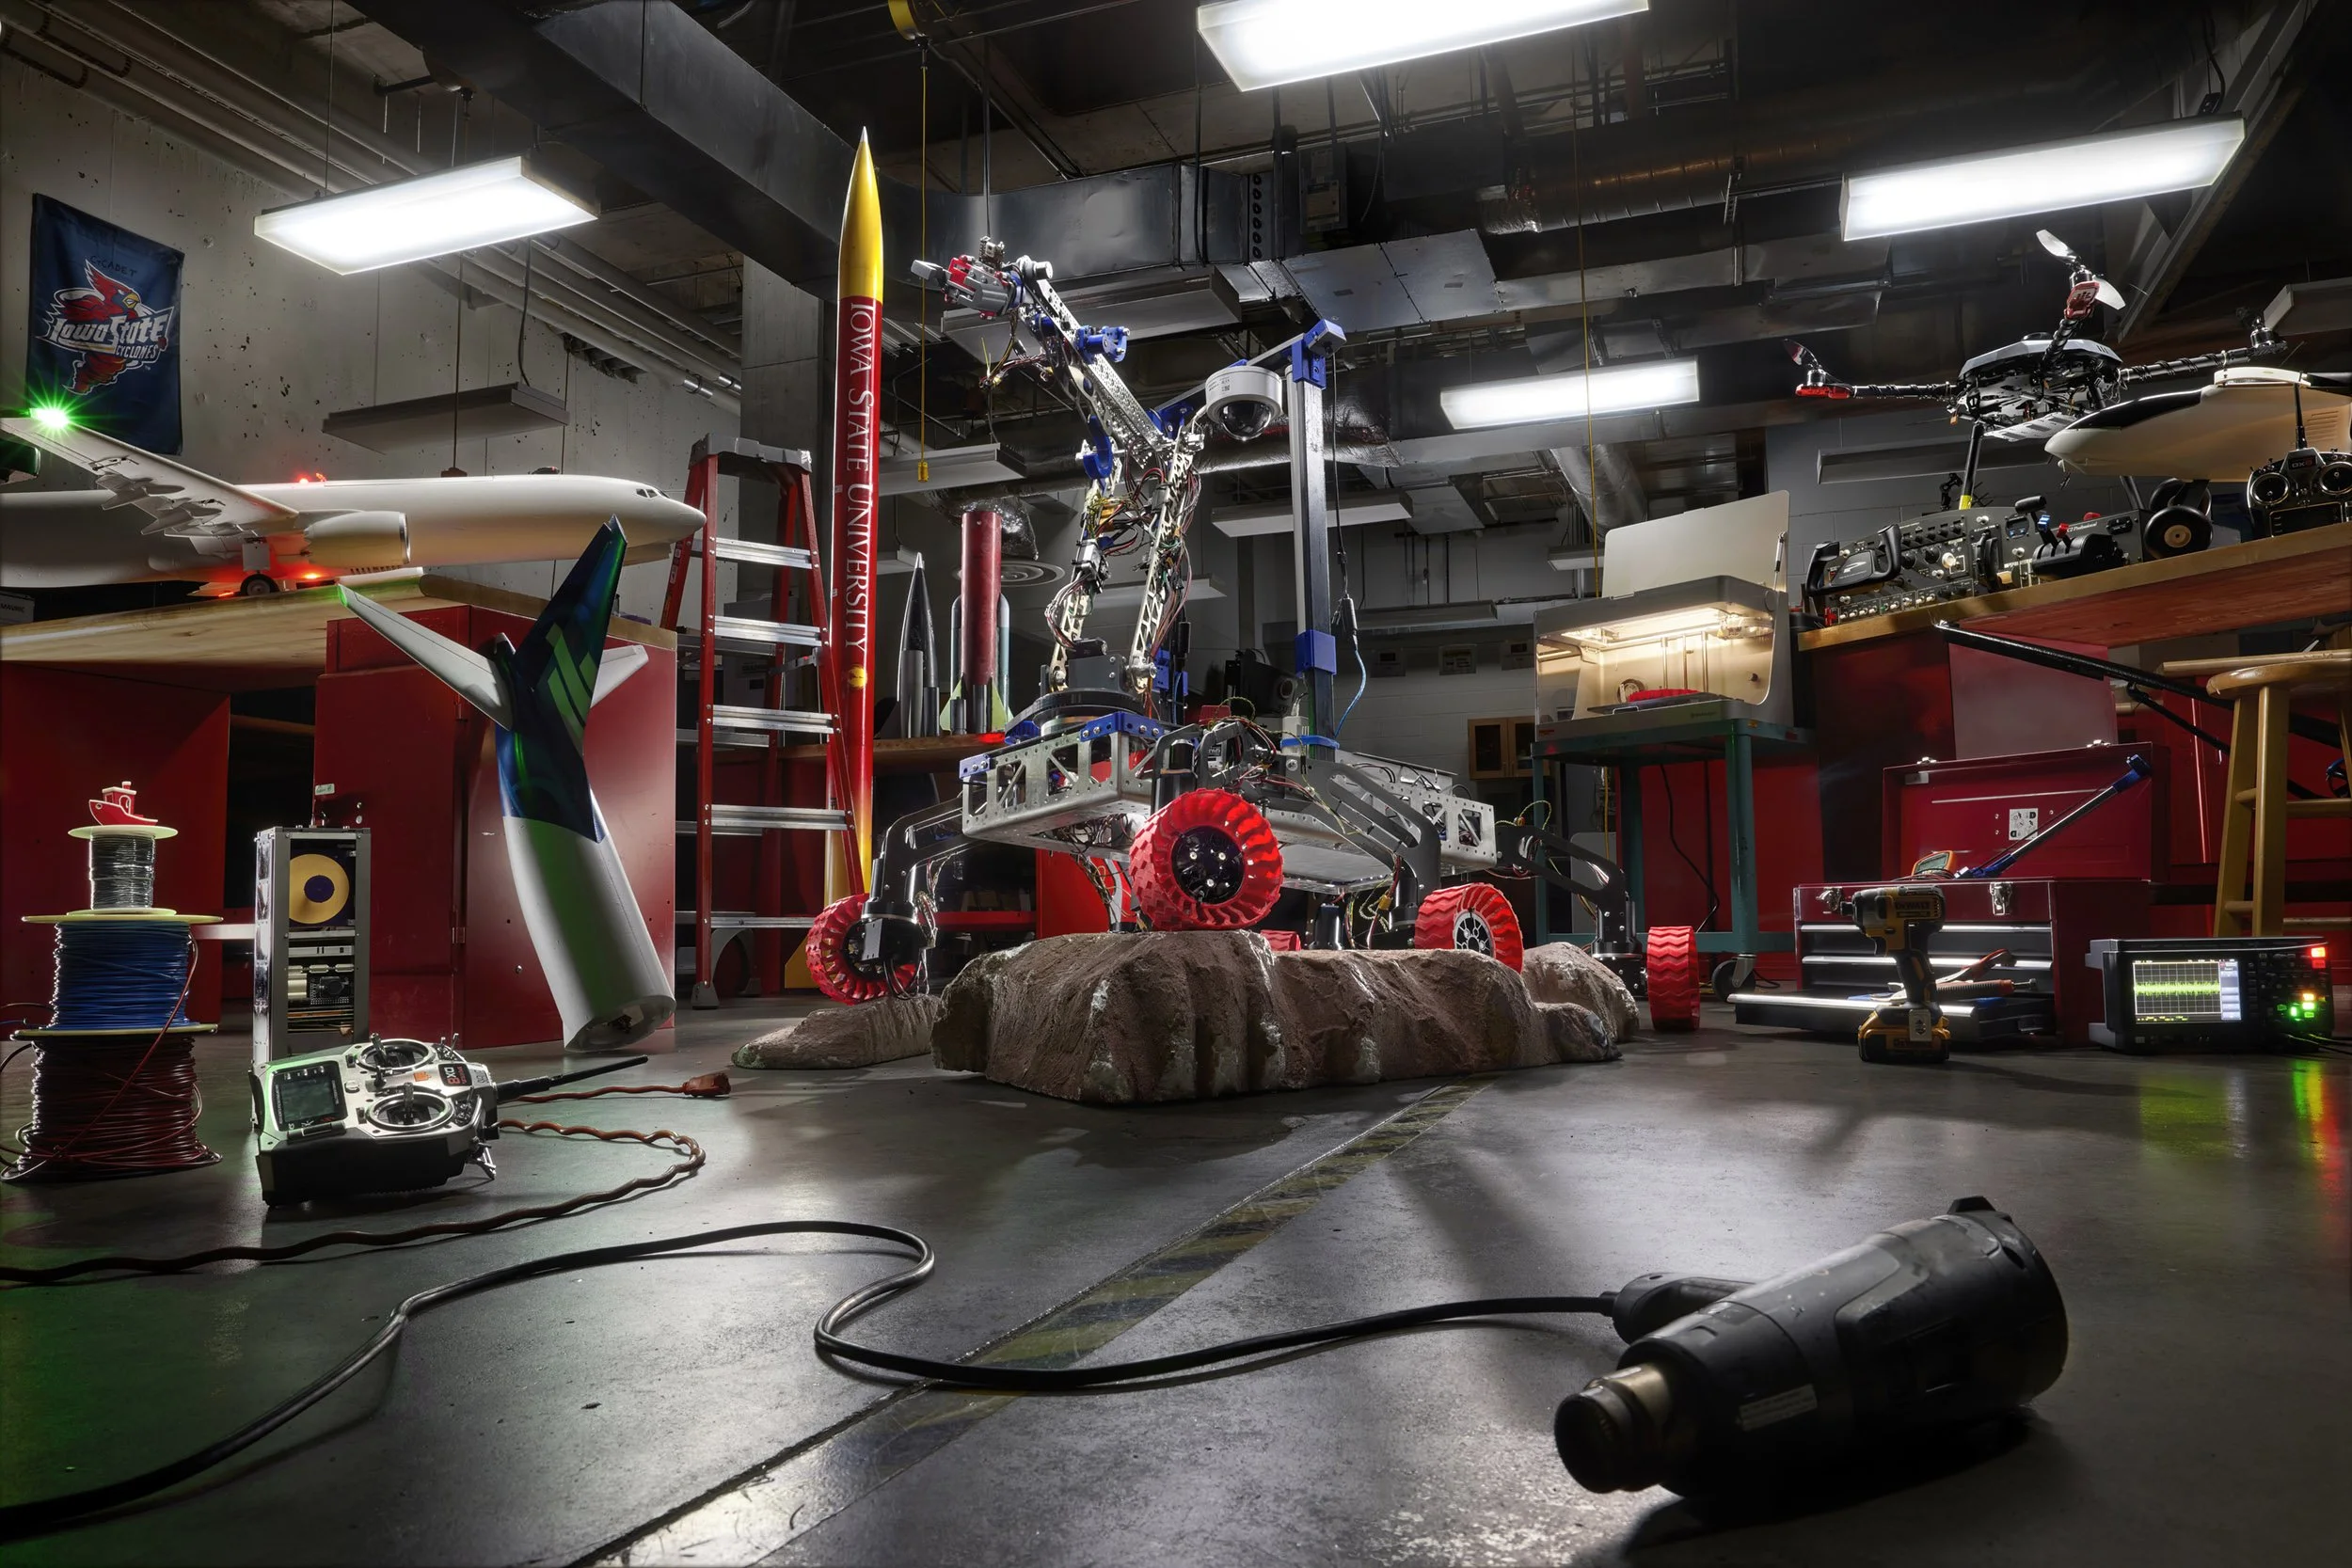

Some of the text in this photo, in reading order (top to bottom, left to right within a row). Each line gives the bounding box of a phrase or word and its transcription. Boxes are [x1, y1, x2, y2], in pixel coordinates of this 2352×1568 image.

[116, 344, 159, 359] CYCLONES
[845, 302, 875, 653] IOWA STATE UNIVERSITY
[443, 1067, 461, 1085] DX8
